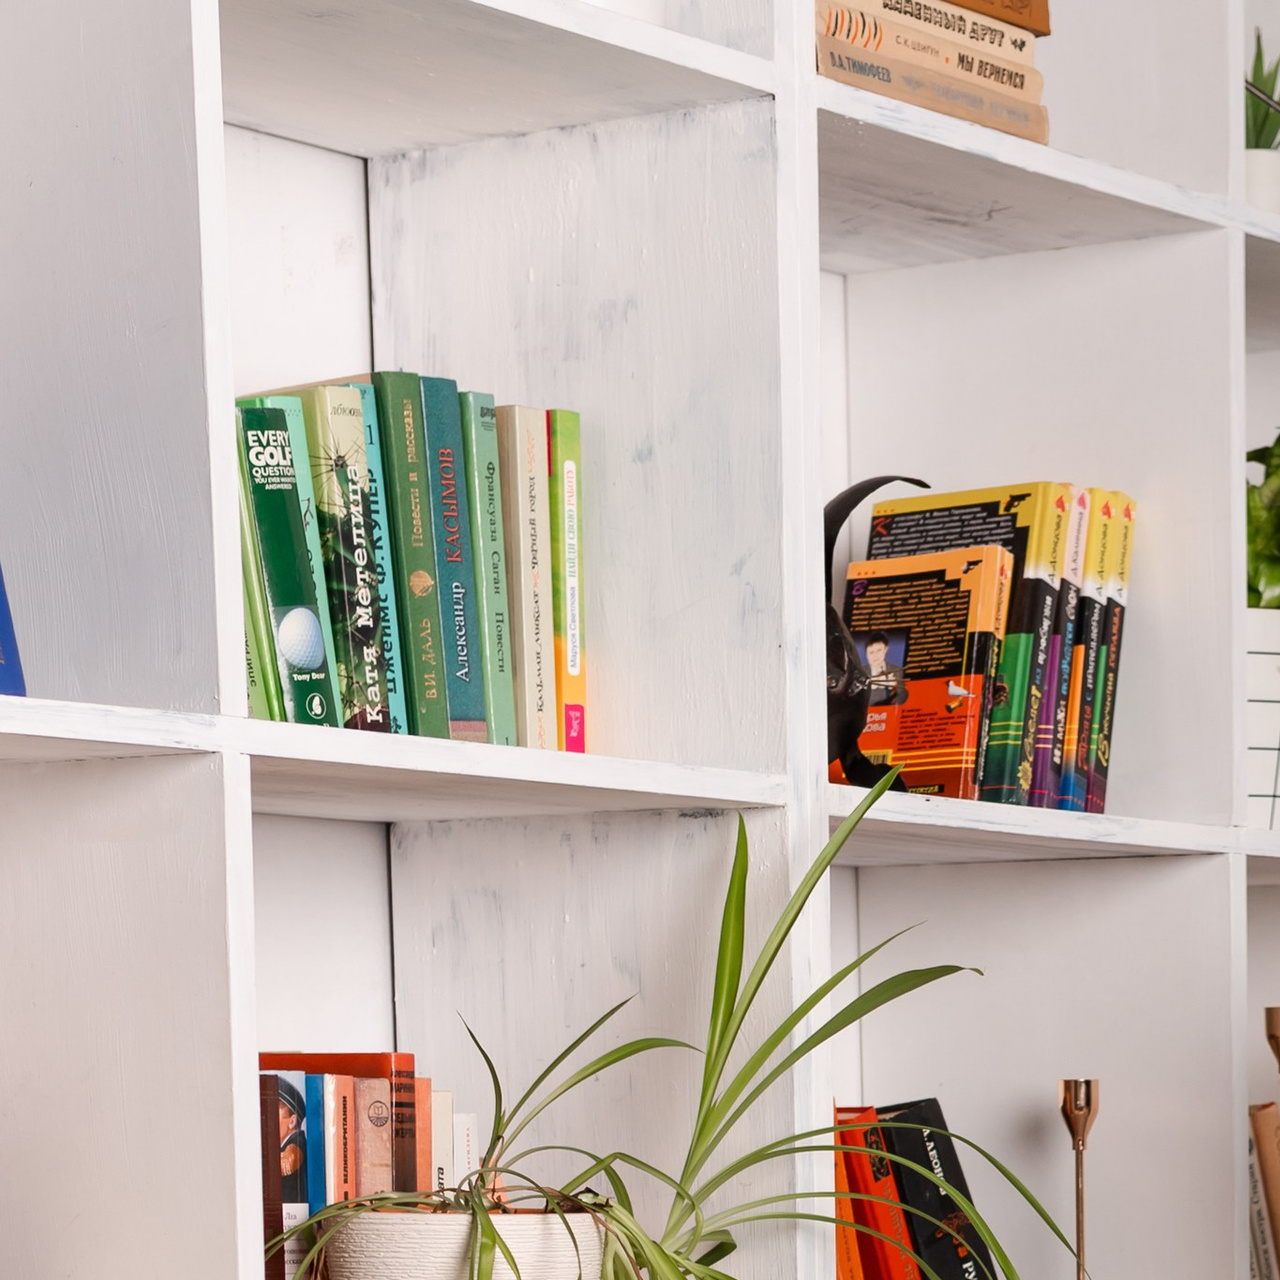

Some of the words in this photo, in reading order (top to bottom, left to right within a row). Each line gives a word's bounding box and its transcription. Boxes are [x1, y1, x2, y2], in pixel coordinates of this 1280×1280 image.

[247, 430, 290, 448] EVERY
[347, 463, 374, 628] Метелица
[439, 448, 463, 563] КАСЫМОВ
[451, 582, 470, 682] Александр
[363, 646, 383, 724] Катя
